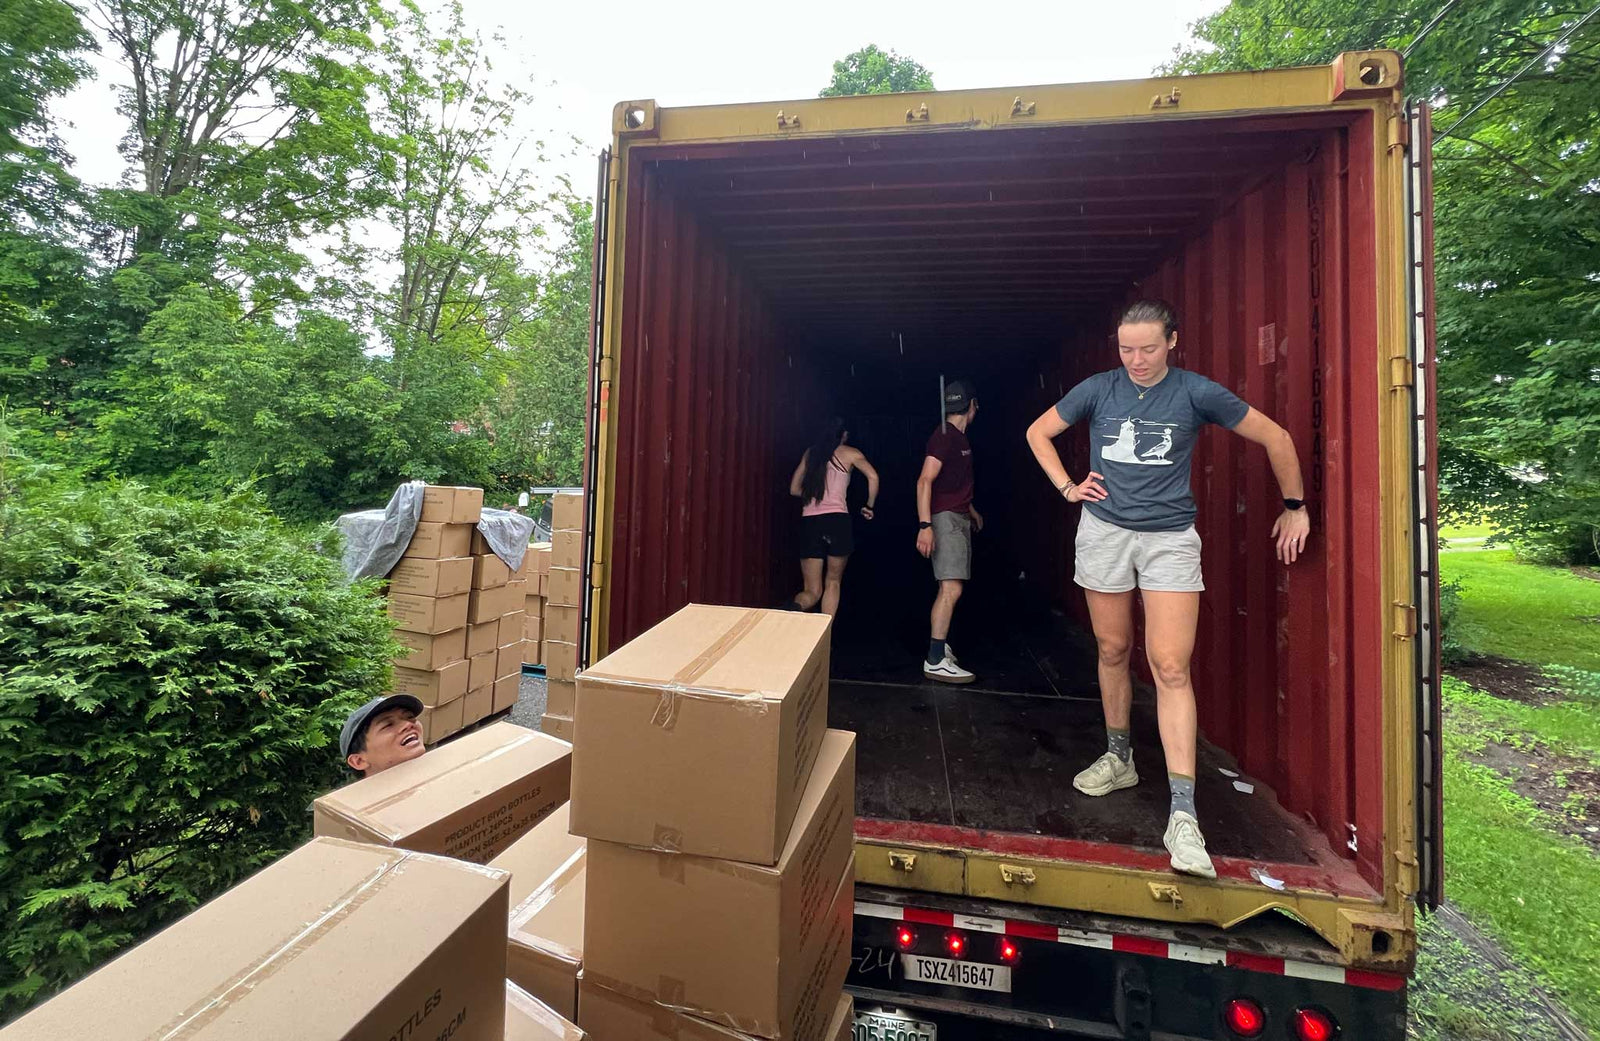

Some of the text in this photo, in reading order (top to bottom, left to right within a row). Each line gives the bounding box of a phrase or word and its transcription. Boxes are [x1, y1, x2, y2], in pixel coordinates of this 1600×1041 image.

[445, 816, 486, 845] PRODUCT
[508, 786, 542, 811] BOTTLES
[917, 959, 995, 987] TSXZ415647
[869, 1016, 906, 1031] MAINE
